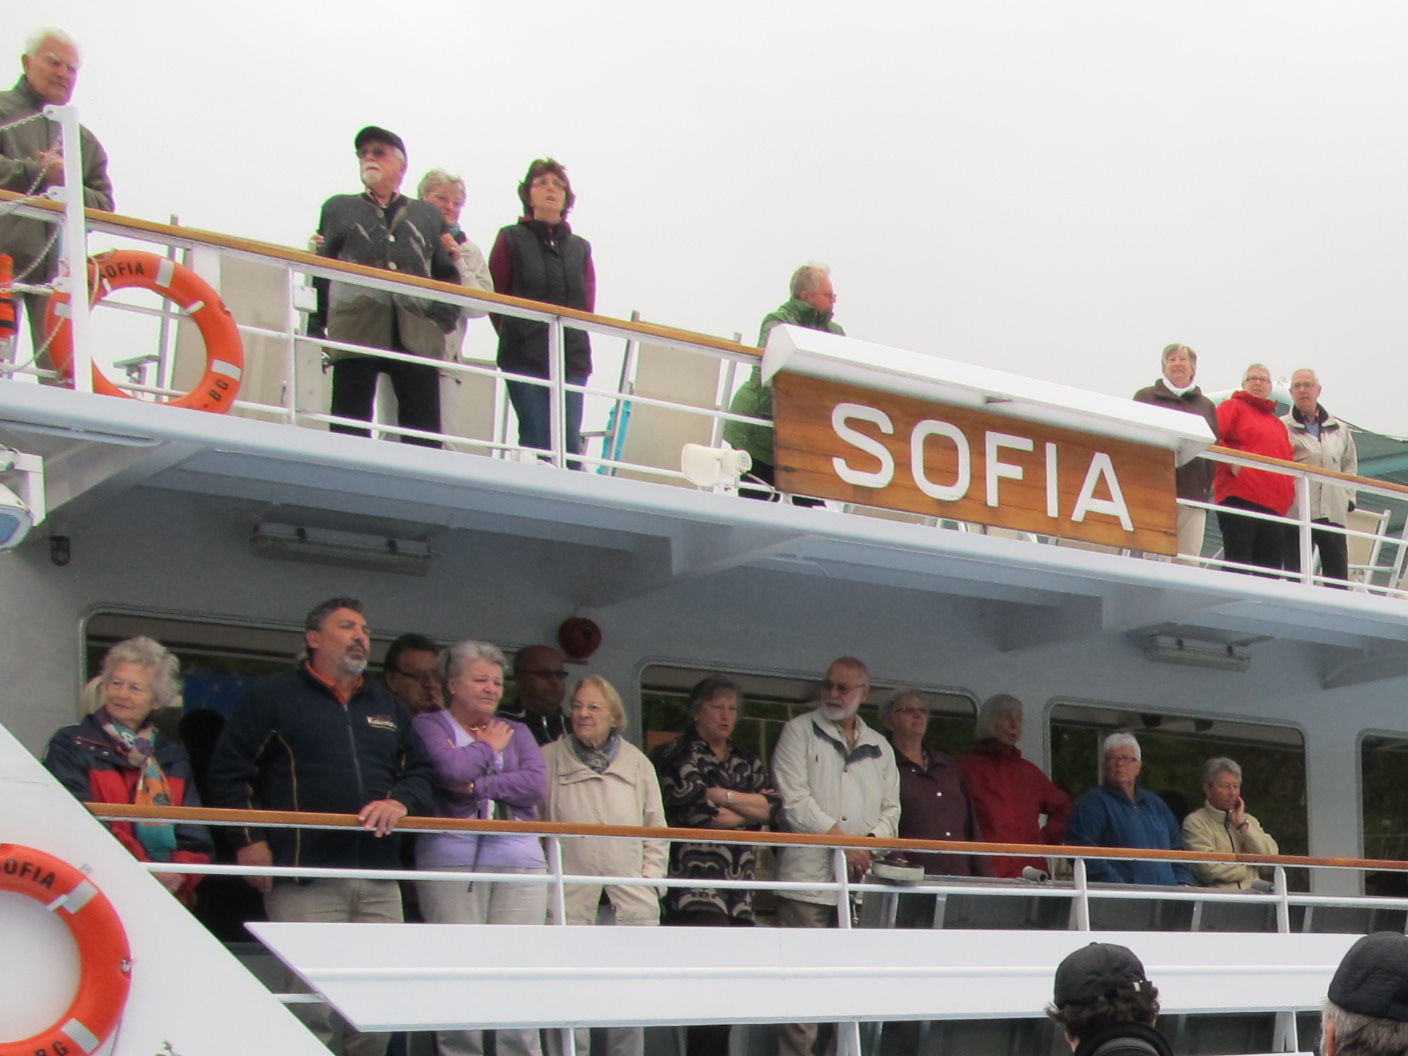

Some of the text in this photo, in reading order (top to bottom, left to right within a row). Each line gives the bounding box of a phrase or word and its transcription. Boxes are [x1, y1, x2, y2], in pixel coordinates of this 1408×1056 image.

[99, 262, 145, 278] OFIA
[831, 402, 1135, 532] SOFIA
[0, 858, 56, 890] OFIA
